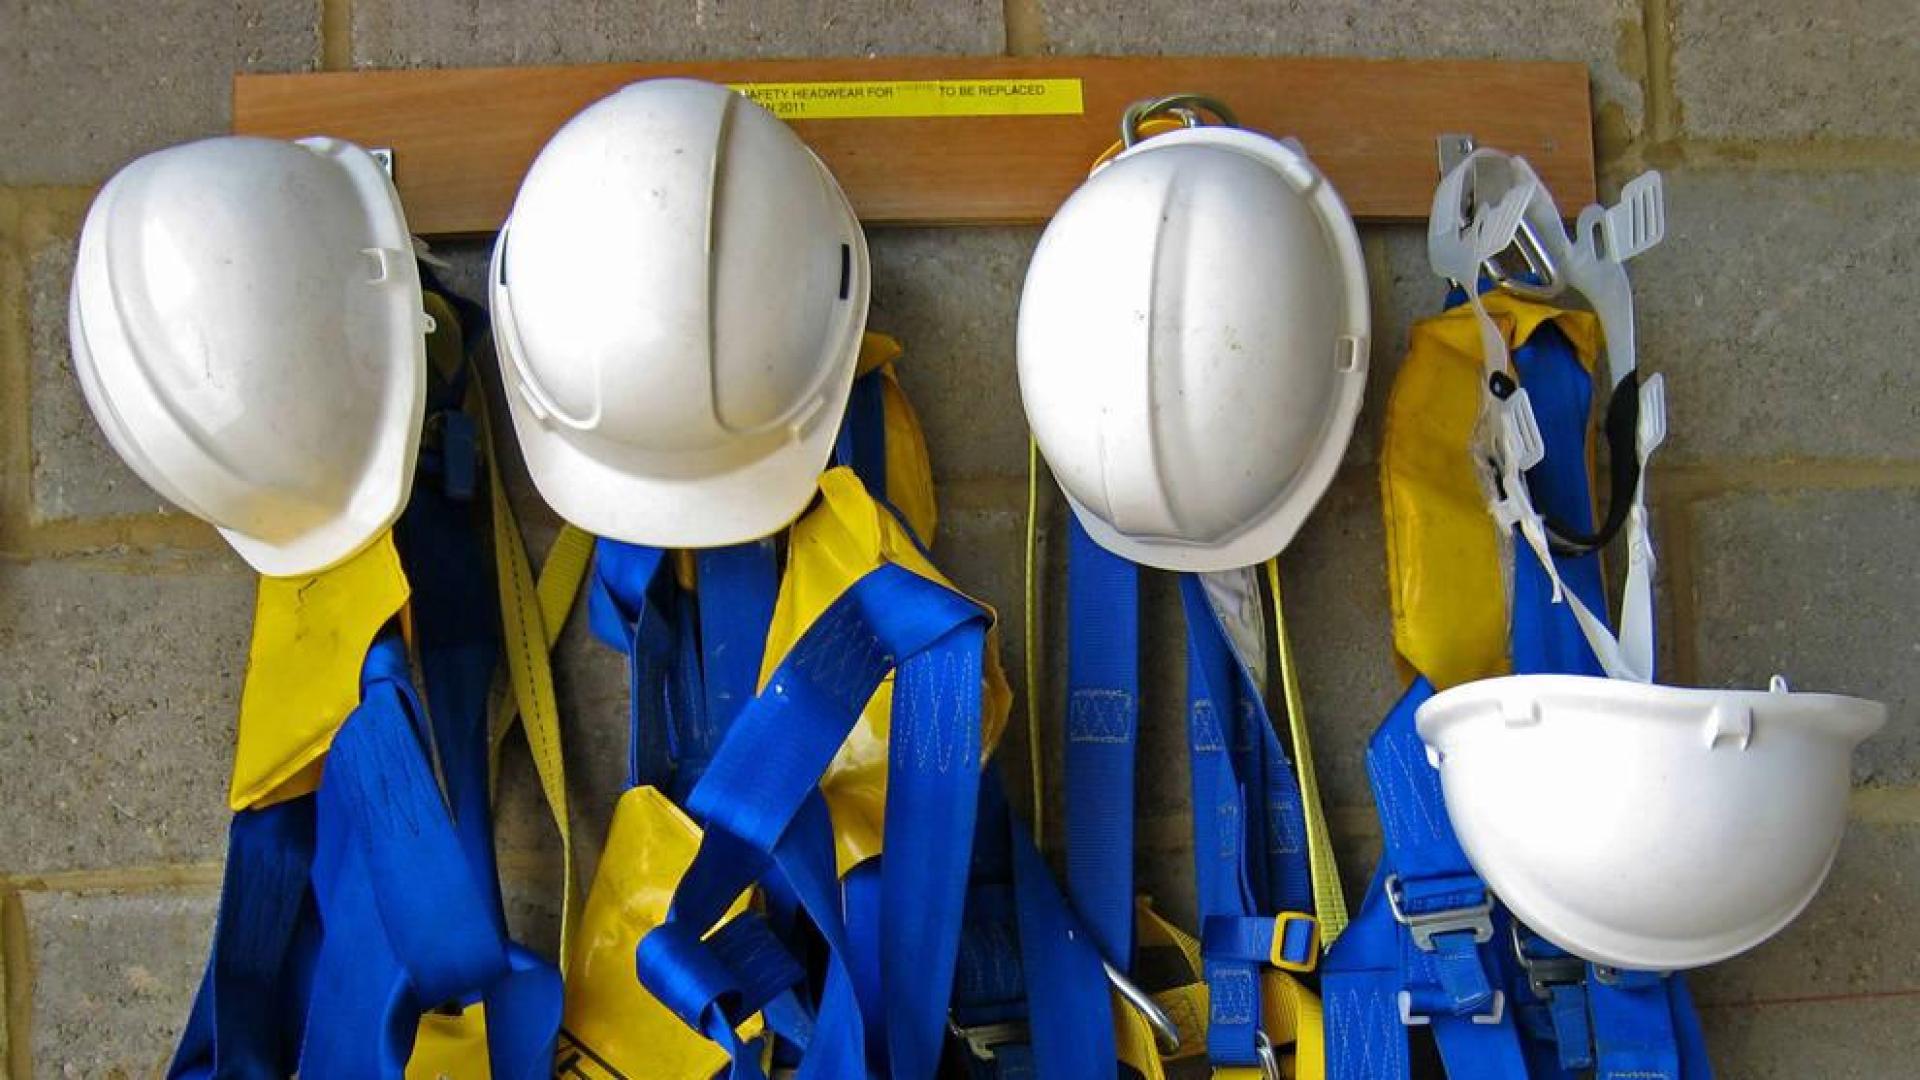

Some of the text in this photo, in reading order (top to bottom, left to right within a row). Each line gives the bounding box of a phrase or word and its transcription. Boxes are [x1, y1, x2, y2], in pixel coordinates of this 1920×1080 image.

[792, 87, 864, 98] HEADWEAR
[867, 86, 893, 98] FOR
[939, 85, 956, 96] TO
[959, 85, 976, 96] BE
[979, 84, 1045, 96] REPLACED
